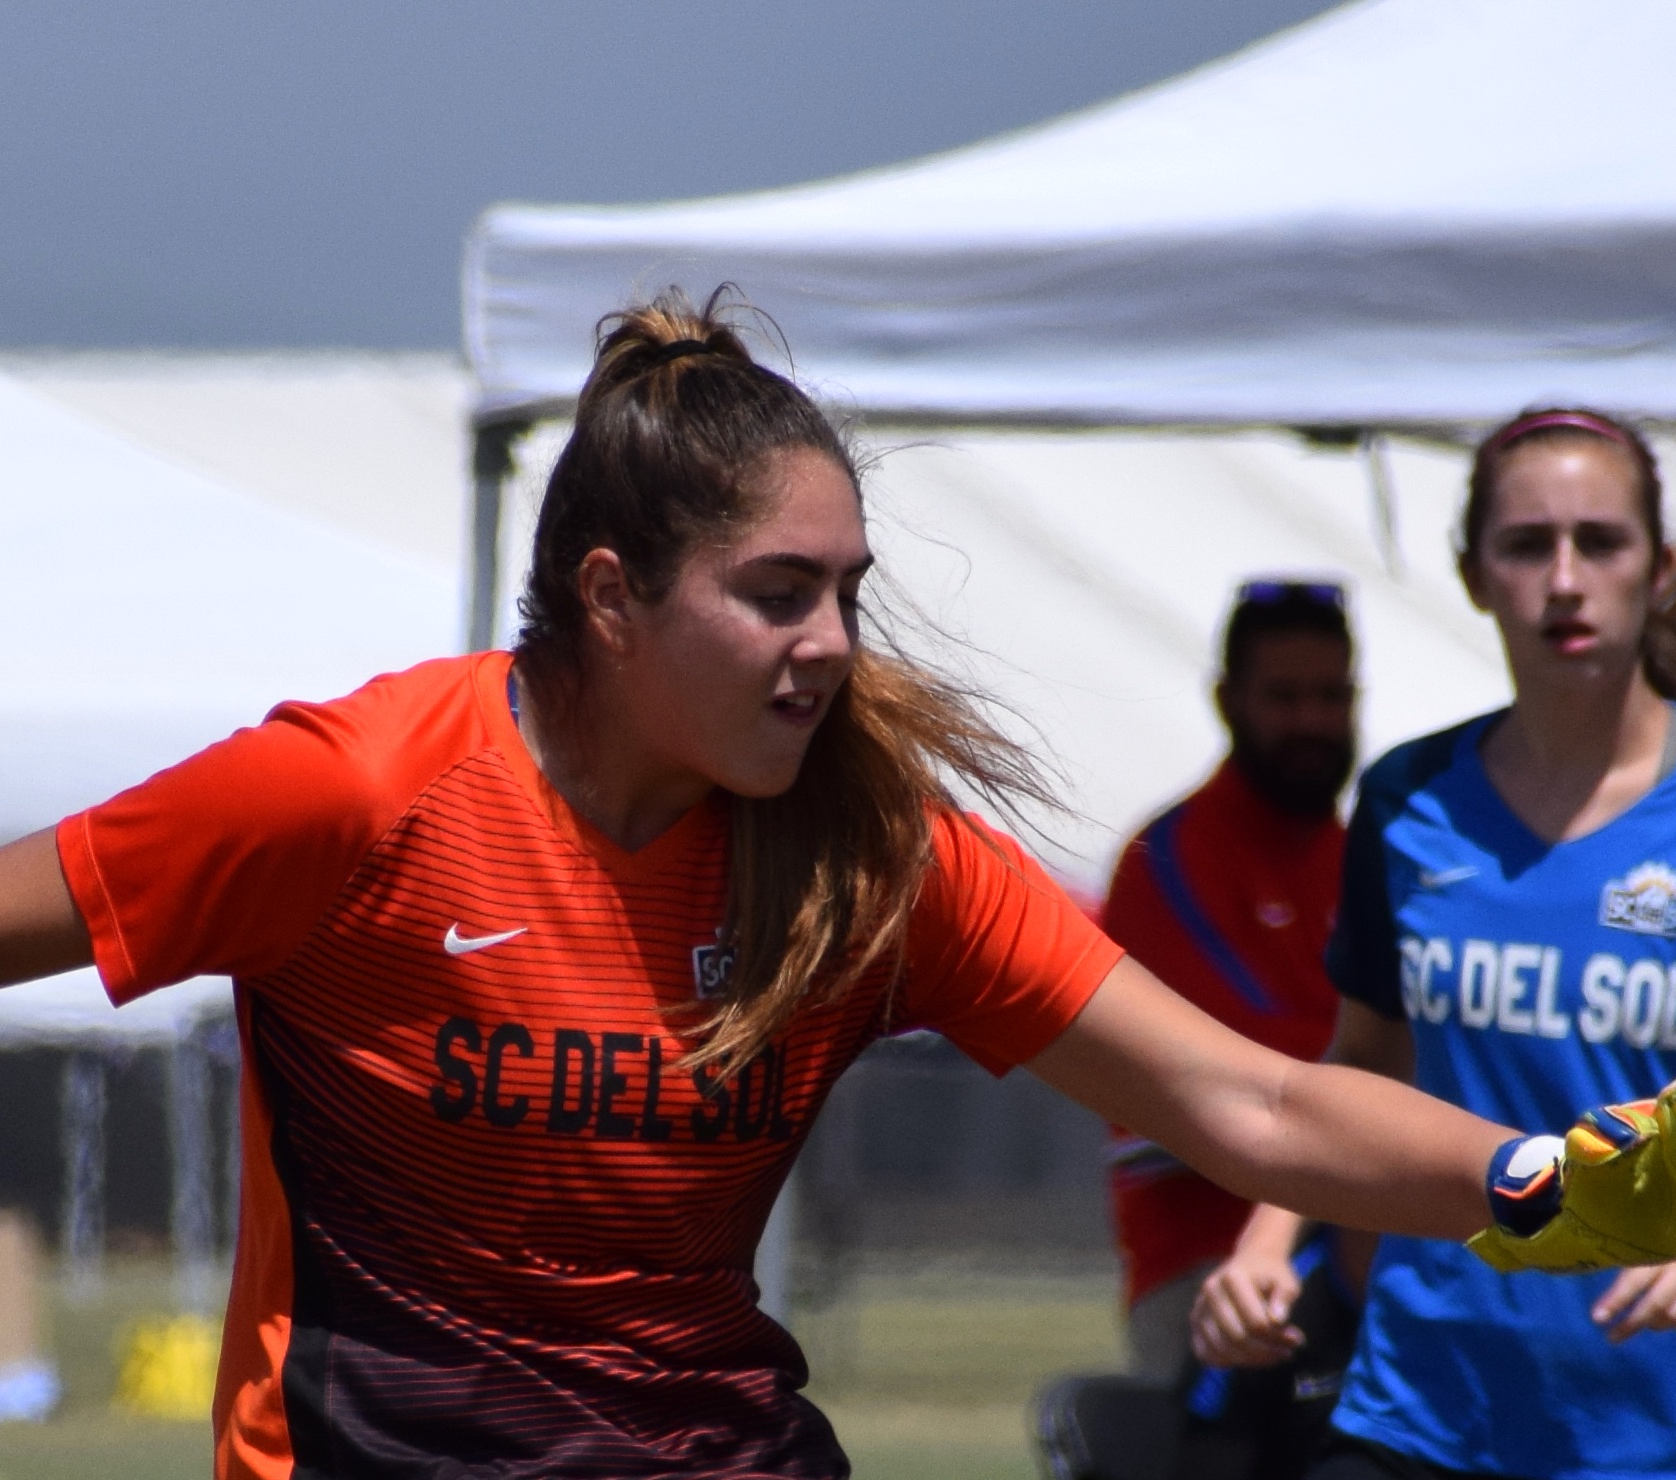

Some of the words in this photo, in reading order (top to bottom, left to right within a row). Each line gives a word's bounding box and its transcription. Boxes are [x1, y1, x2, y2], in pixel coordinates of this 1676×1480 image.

[1400, 936, 1453, 1024] SC
[1460, 939, 1571, 1039] DEL
[430, 1016, 533, 1128] SC
[546, 1028, 672, 1140] DEL
[690, 1034, 793, 1142] SOL
